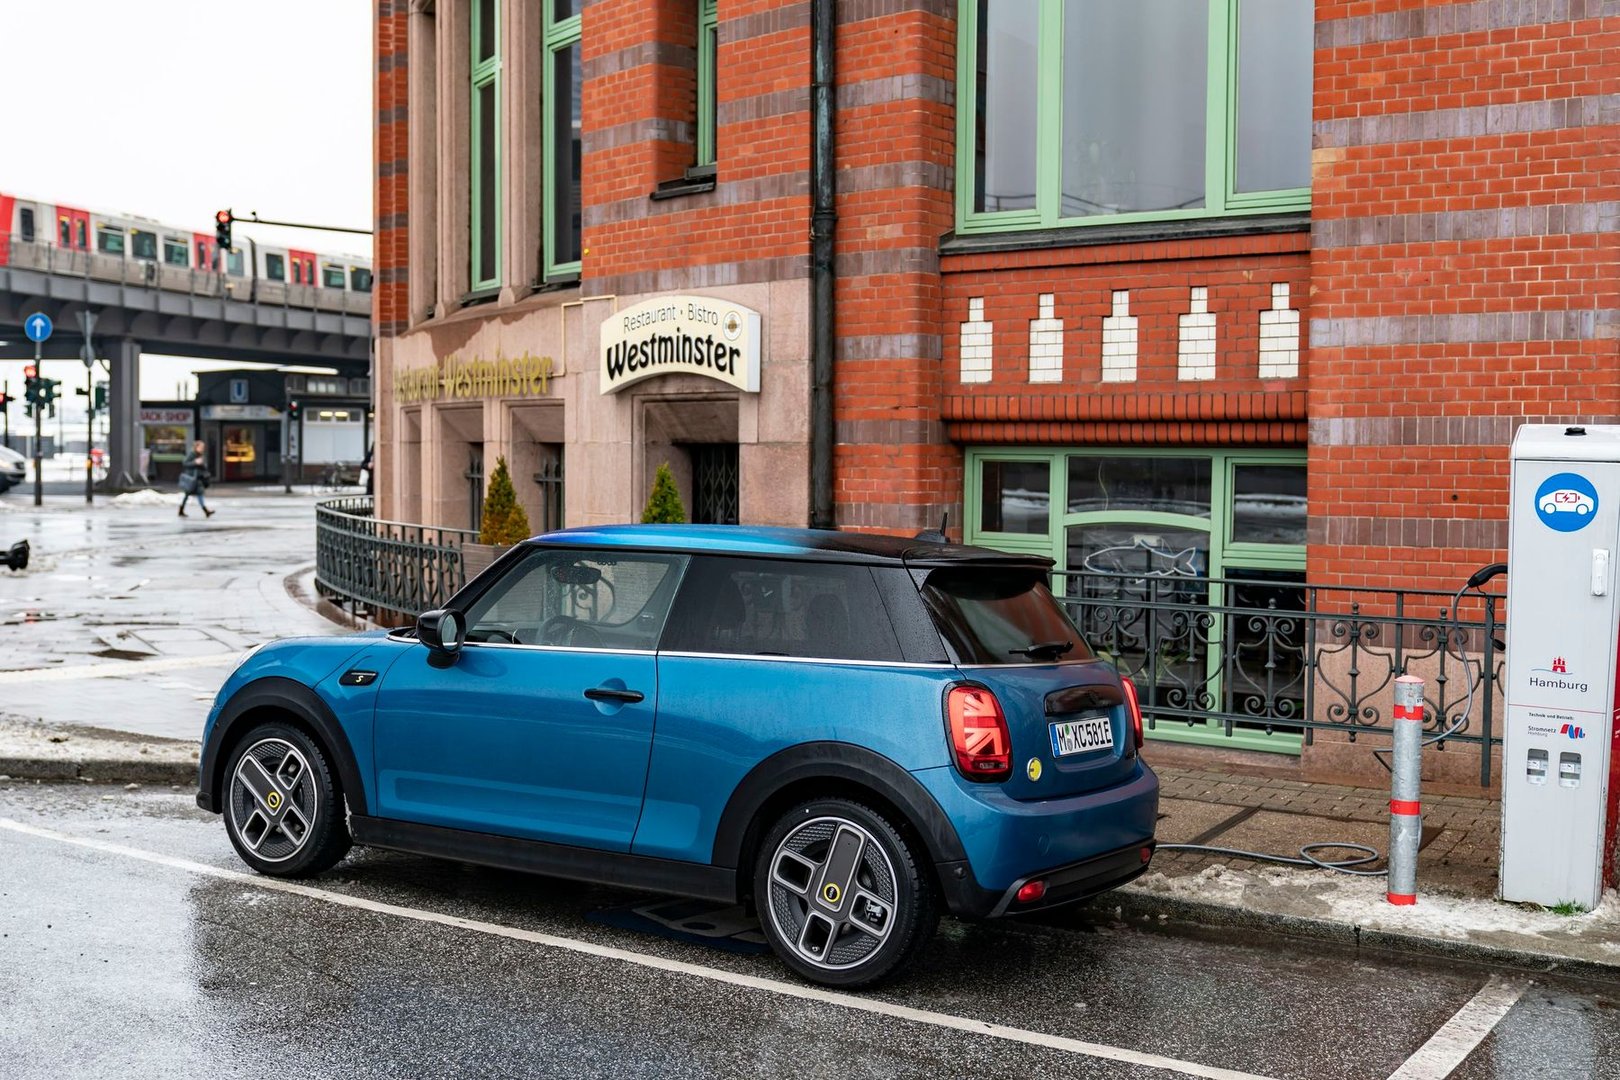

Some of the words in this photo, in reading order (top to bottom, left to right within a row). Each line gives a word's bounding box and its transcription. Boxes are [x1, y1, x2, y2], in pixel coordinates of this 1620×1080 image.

[623, 305, 676, 334] Restaurant
[687, 303, 719, 326] Bistro
[606, 326, 741, 382] Westminster
[443, 347, 553, 399] Westminster
[1529, 677, 1588, 693] Hamburg
[1057, 726, 1068, 752] M
[1528, 725, 1557, 734] Stromnetz
